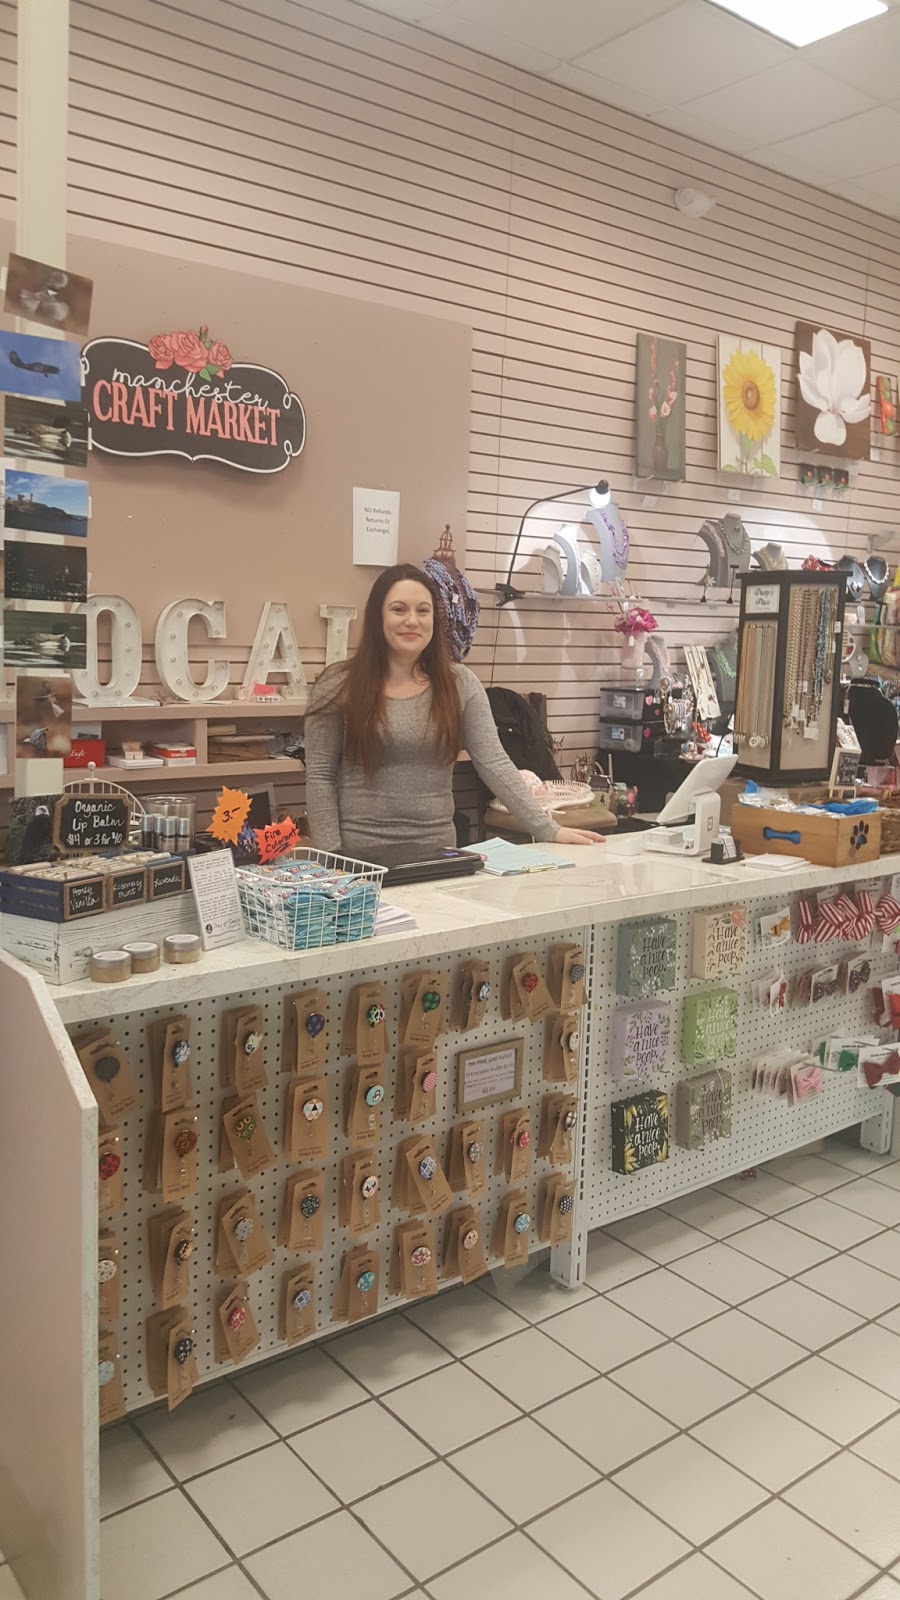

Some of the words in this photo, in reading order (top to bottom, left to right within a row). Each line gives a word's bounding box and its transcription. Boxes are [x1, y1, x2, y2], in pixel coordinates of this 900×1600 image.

[112, 368, 269, 409] manchester
[92, 379, 178, 431] CRAFT
[185, 394, 281, 447] MARKET
[373, 507, 392, 515] Refunds
[365, 516, 384, 524] Returns
[366, 526, 391, 535] Exchanges
[70, 748, 86, 760] Eagle
[75, 800, 116, 818] Organic
[72, 818, 88, 833] Lip
[92, 814, 125, 828] Balm
[84, 836, 93, 846] or
[93, 833, 100, 845] 3
[101, 833, 111, 845] for
[264, 829, 281, 842] Fire
[265, 827, 297, 853] Colorant
[72, 886, 94, 898] Honey
[70, 894, 100, 911] Vanilla
[716, 924, 738, 940] Have
[643, 936, 666, 952] Have
[715, 941, 721, 953] a
[722, 938, 738, 952] nice
[640, 953, 647, 965] a
[648, 950, 666, 965] nice
[636, 1023, 659, 1039] Have
[633, 1041, 640, 1052] a
[641, 1036, 660, 1050] nice
[635, 1112, 659, 1132] Have
[634, 1133, 641, 1146] a
[641, 1127, 661, 1145] nice
